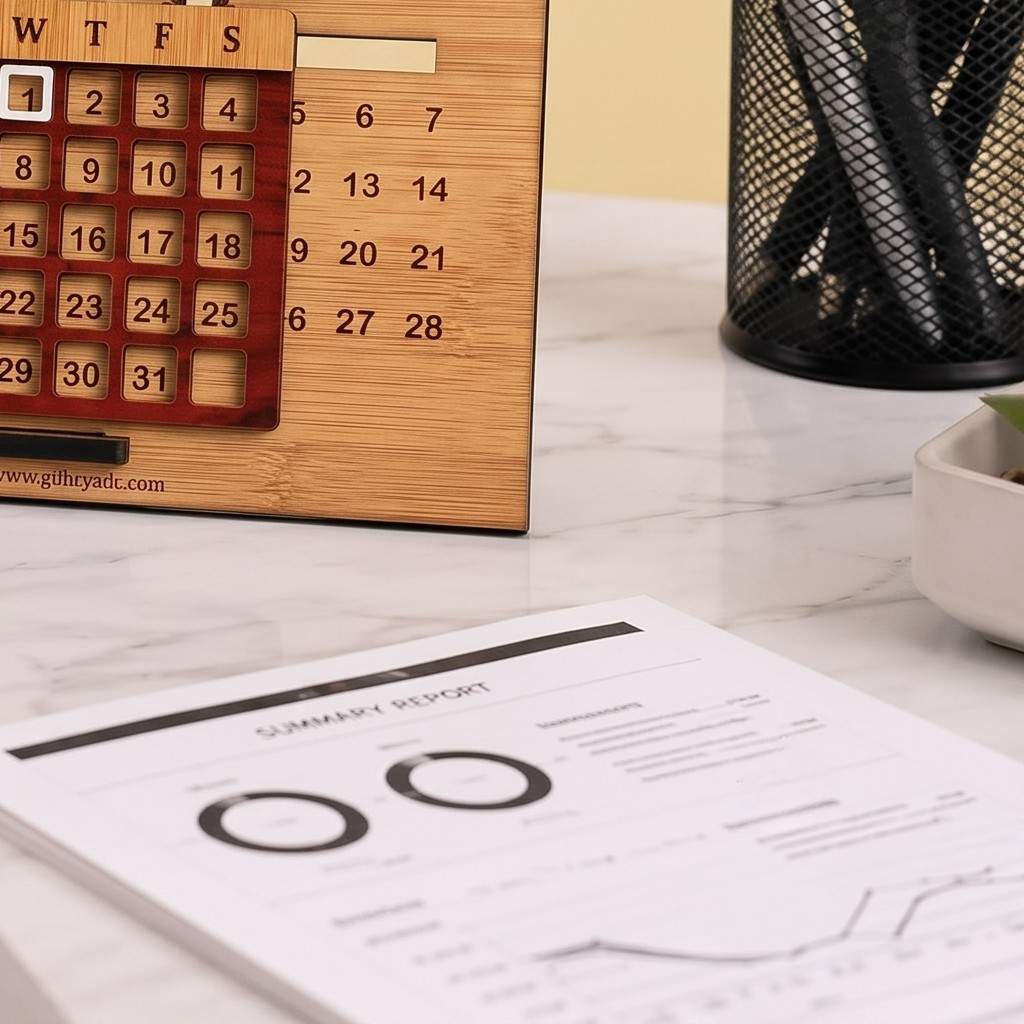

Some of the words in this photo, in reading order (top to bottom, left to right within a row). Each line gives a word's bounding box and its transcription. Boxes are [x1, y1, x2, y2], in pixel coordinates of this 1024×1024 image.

[13, 17, 48, 43] W
[85, 21, 107, 46] T
[154, 23, 172, 49] F
[224, 26, 240, 52] S
[22, 88, 35, 111] 1
[86, 90, 102, 115] 2
[153, 94, 169, 118] 3
[220, 98, 237, 121] 4
[292, 102, 306, 125] 5
[356, 104, 373, 128] 6
[426, 108, 442, 132] 7
[16, 155, 31, 180] 8
[83, 158, 99, 183] 9
[142, 162, 176, 187] 10
[211, 165, 242, 191] 11
[290, 169, 312, 194] 2
[344, 173, 379, 197] 13
[413, 176, 447, 201] 14
[4, 223, 40, 249] 15
[71, 226, 108, 254] 16
[138, 230, 174, 254] 17
[206, 234, 240, 259] 18
[340, 241, 376, 266] 20
[411, 245, 443, 270] 21
[0, 290, 37, 317] 22
[66, 294, 105, 321] 23
[134, 298, 170, 323] 24
[202, 302, 240, 328] 25
[336, 309, 375, 335] 27
[405, 314, 442, 340] 28
[64, 361, 99, 387] 30
[133, 366, 165, 391] 31
[255, 704, 384, 740] SUMMARY
[391, 681, 491, 709] REPORT
